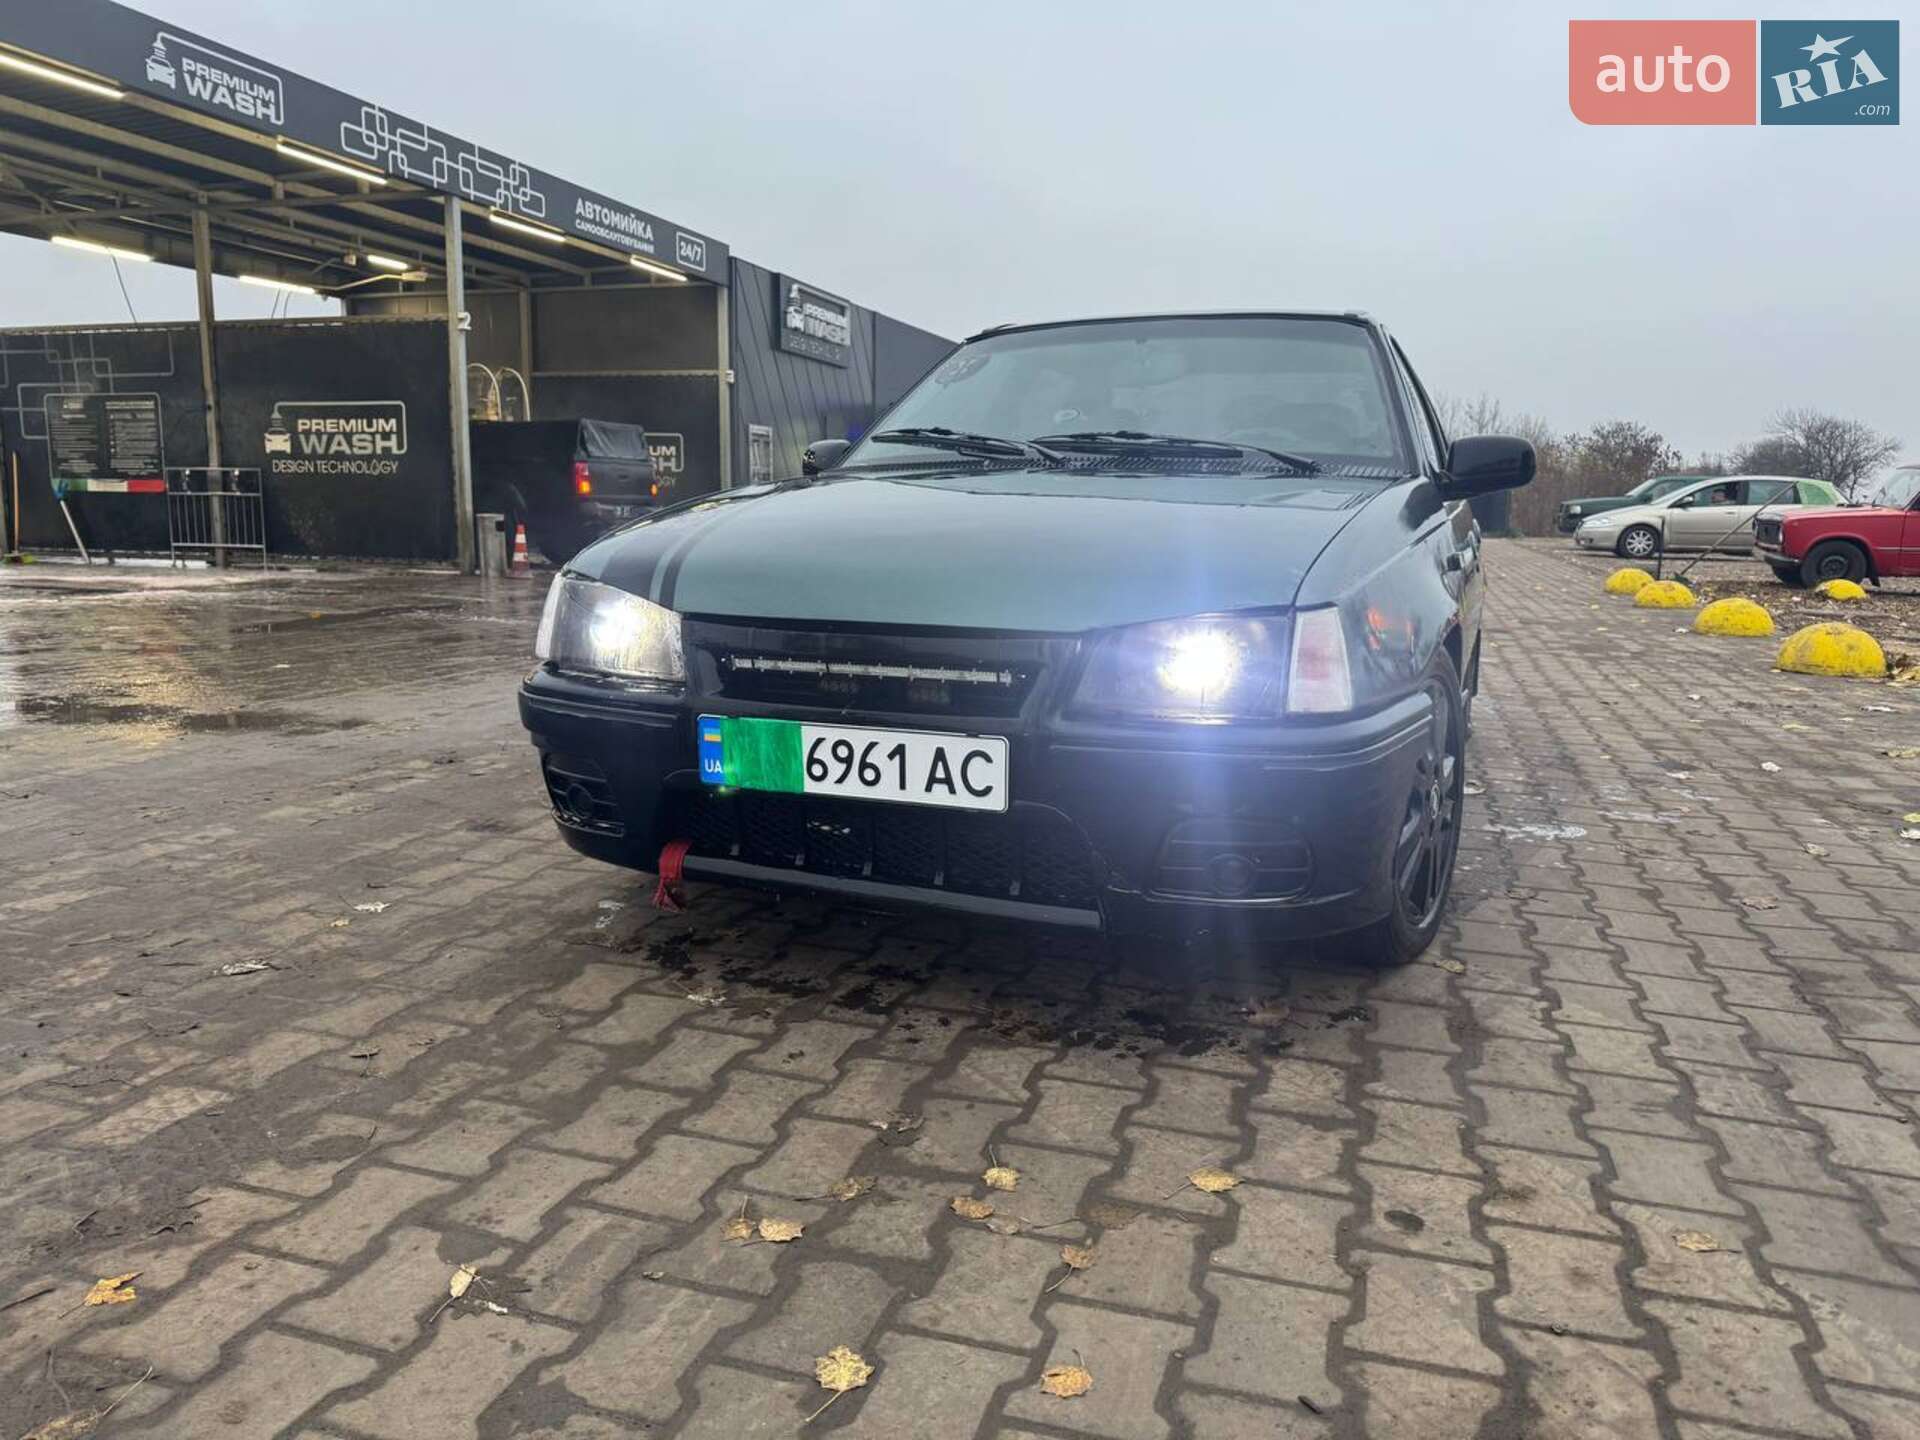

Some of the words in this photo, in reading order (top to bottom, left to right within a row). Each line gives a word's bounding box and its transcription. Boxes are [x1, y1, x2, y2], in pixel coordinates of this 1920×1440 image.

[181, 57, 275, 104] PREMIUM
[183, 72, 278, 124] WASH
[575, 197, 654, 241] АВТОМИЙКА
[680, 240, 702, 262] 24/7
[297, 418, 397, 432] PREMIUM
[300, 433, 398, 454] WASH
[272, 459, 314, 473] DESIGN
[316, 458, 399, 475] TECHNOLOGY
[704, 759, 722, 773] UA
[806, 737, 906, 790] 6961
[924, 746, 994, 798] AC
